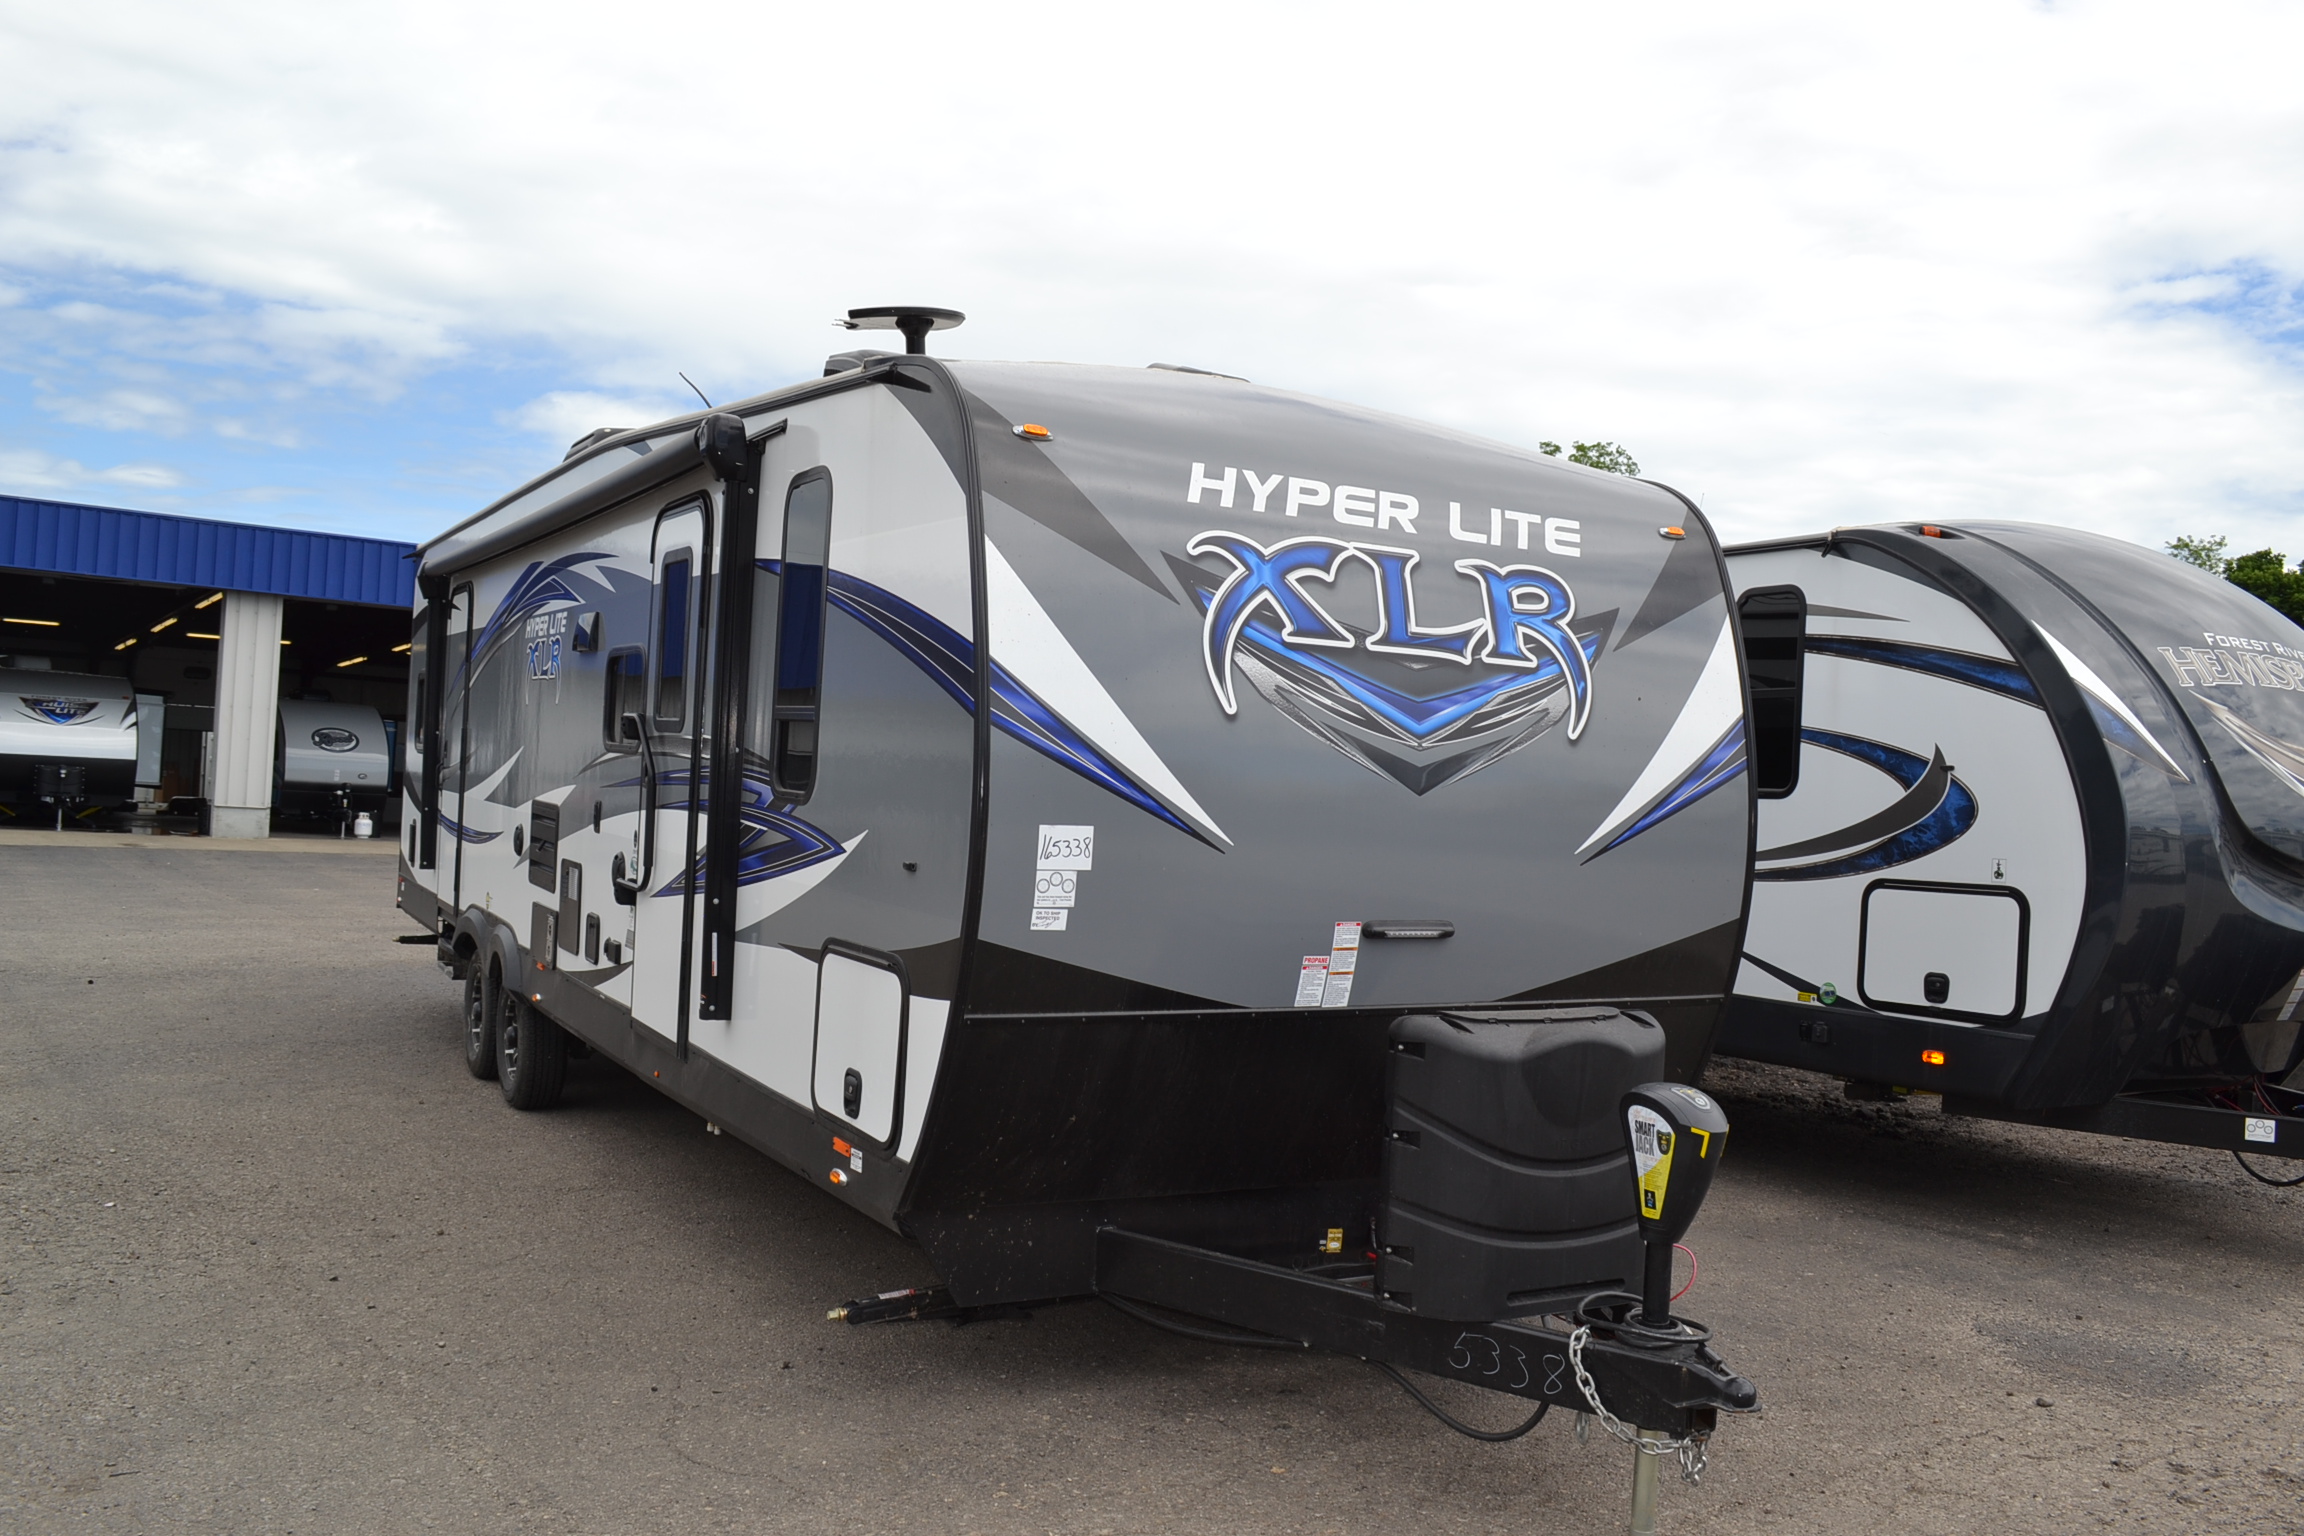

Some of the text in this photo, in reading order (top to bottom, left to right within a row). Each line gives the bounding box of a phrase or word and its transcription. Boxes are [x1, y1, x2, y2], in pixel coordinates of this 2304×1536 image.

[1186, 462, 1582, 557] HYPER LITE
[525, 611, 568, 639] HYPER LITE
[1186, 530, 1592, 740] XLR
[2203, 632, 2270, 653] FOREST
[526, 635, 562, 705] XLR
[1039, 834, 1092, 860] 165338
[1634, 1119, 1656, 1138] SMART
[1635, 1133, 1655, 1157] JACK
[1449, 1331, 1566, 1395] 5338
